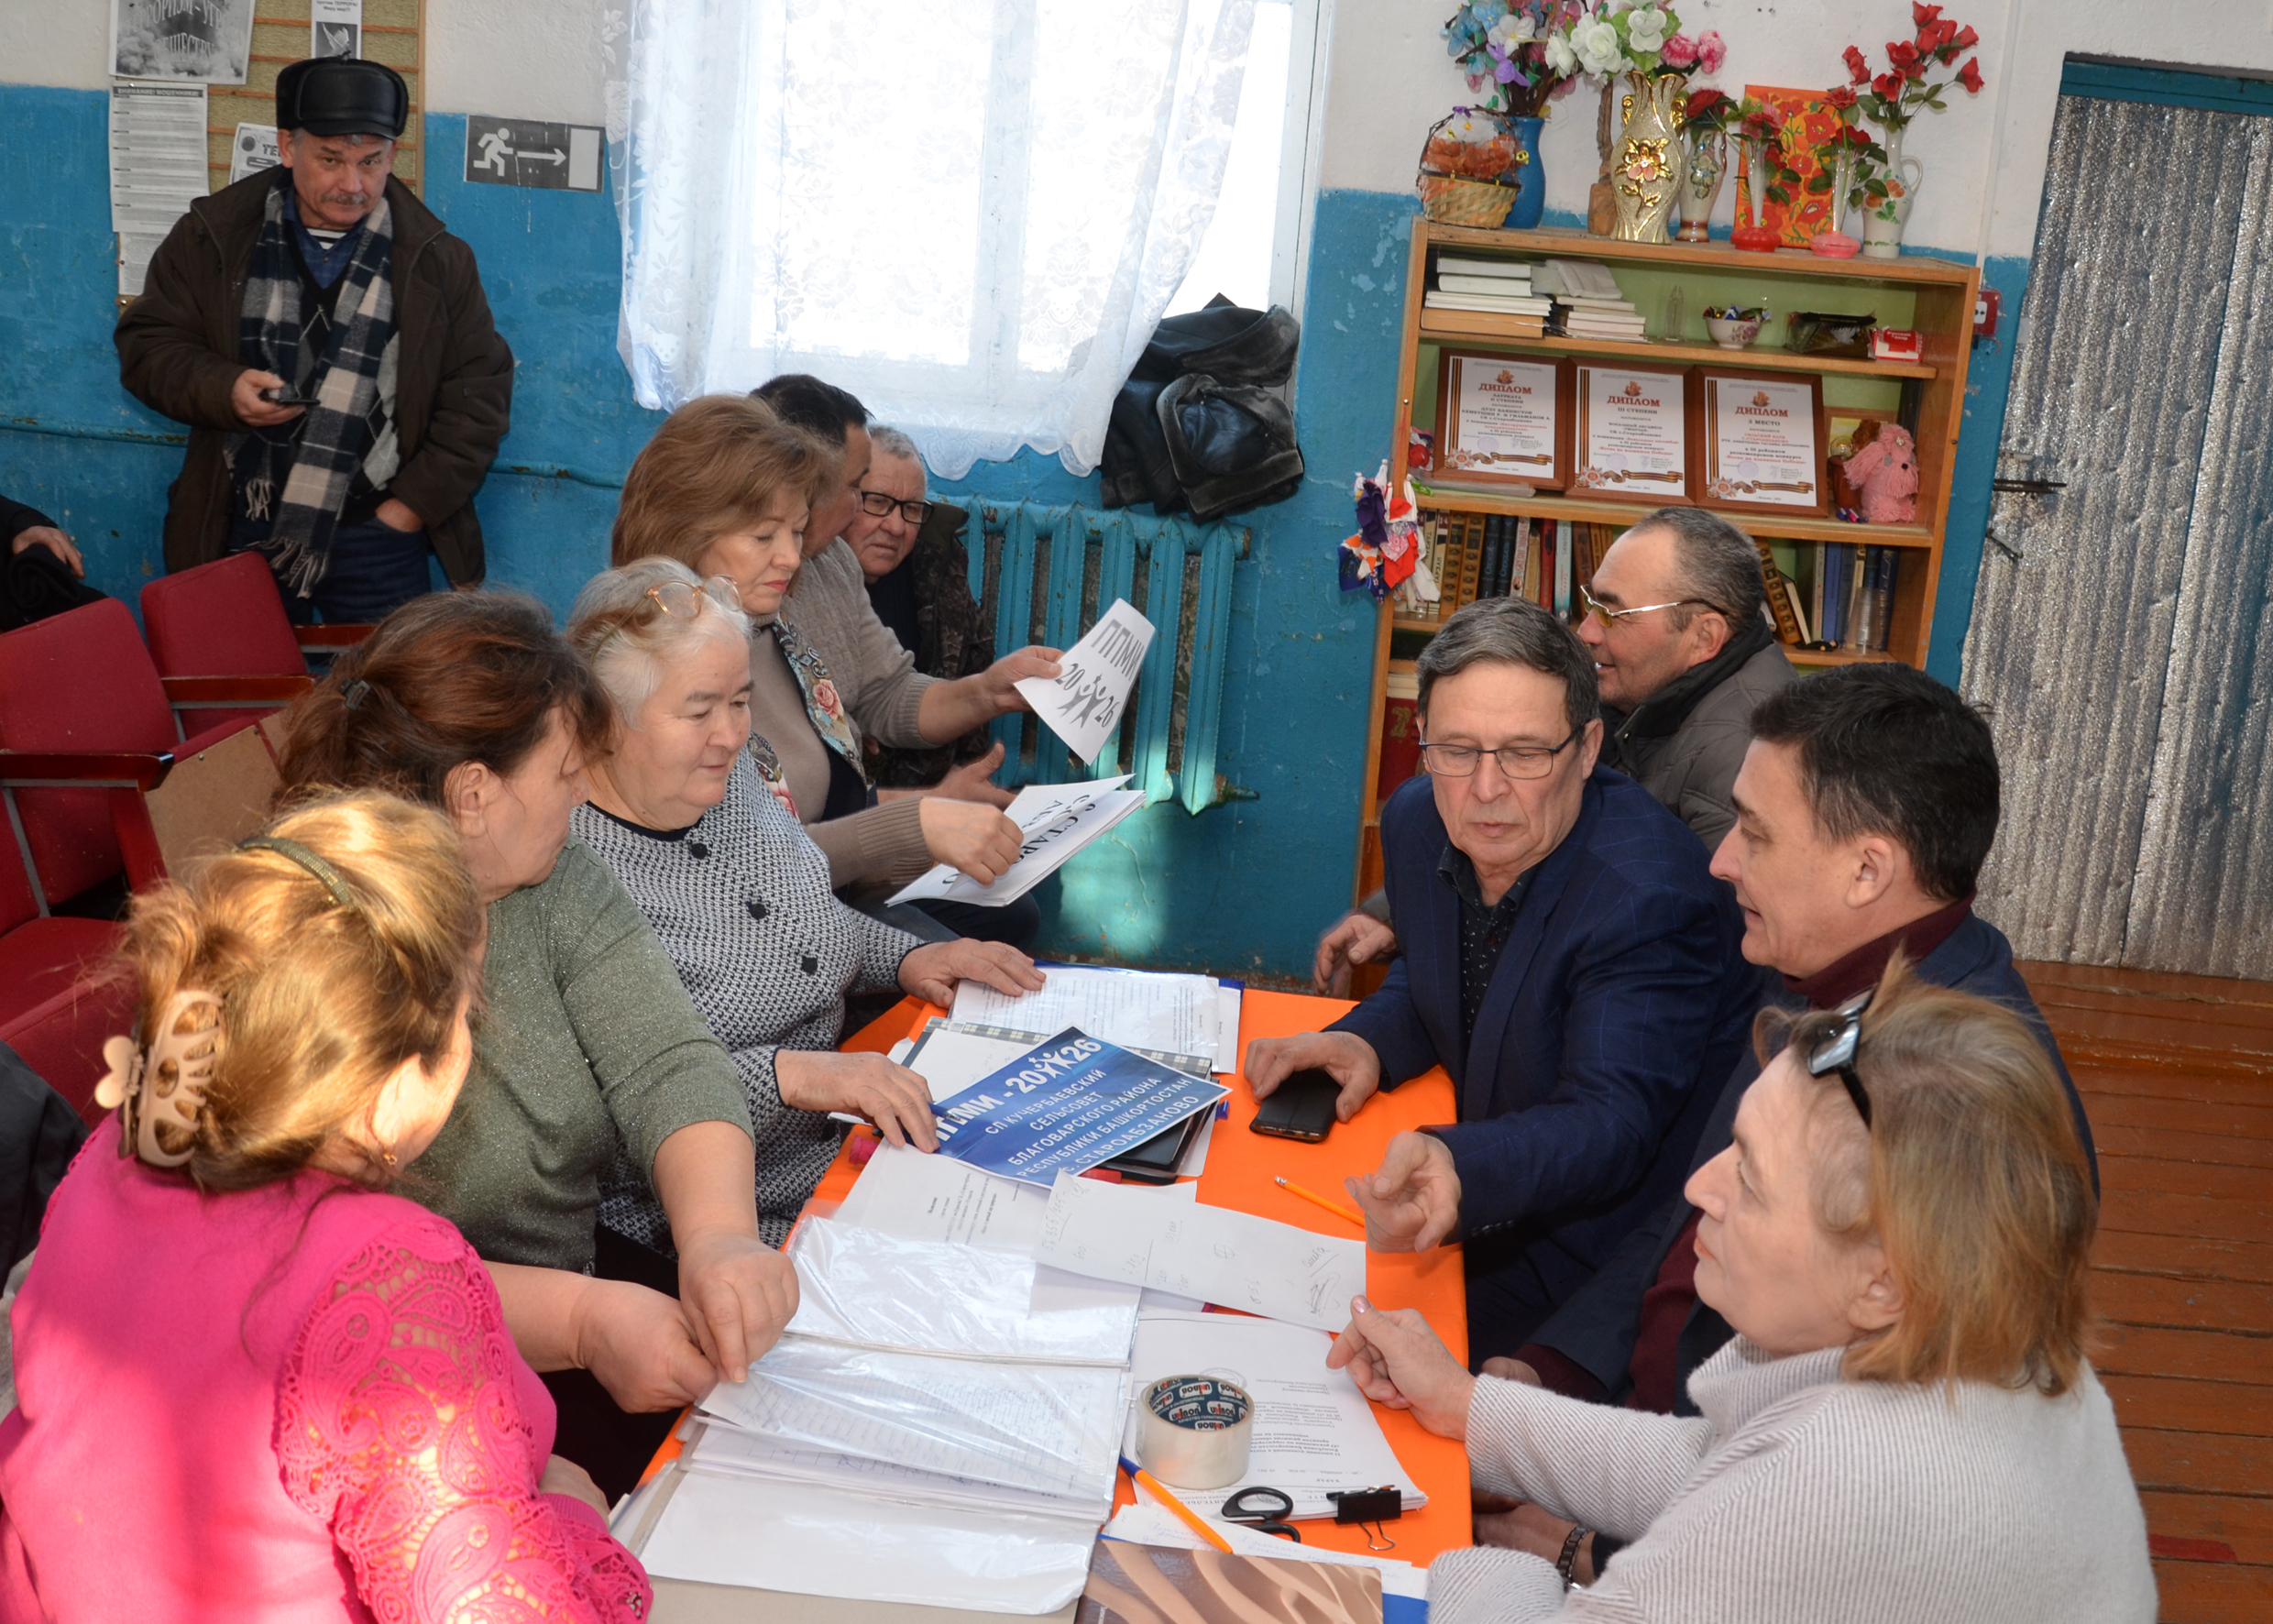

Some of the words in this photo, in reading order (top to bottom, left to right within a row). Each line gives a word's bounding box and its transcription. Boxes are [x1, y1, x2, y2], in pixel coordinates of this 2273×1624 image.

[1477, 382, 1532, 394] ДИПЛОМ
[1608, 396, 1660, 407] ДИПЛОМ
[1735, 406, 1788, 417] ДИПЛОМ
[1092, 619, 1145, 681] ППМИ
[1055, 663, 1085, 691] 20
[1094, 696, 1120, 728] 26
[1005, 1070, 1047, 1093] 20
[1060, 1039, 1102, 1062] 26
[985, 1121, 1008, 1135] СП
[1007, 1069, 1106, 1125] КУЧЕРБАЕВСКИЙ
[1008, 1104, 1114, 1166] БЛАГОВАРСКОГО
[1111, 1078, 1161, 1108] РАЙОНА
[1016, 1131, 1100, 1178] РЕСПУБЛИКИ
[1097, 1079, 1192, 1135] БАШКОРТОСТАН
[1029, 1092, 1104, 1131] СЕЛЬСОВЕТ
[1075, 1096, 1199, 1165] СТАРОАБЗАНОВО
